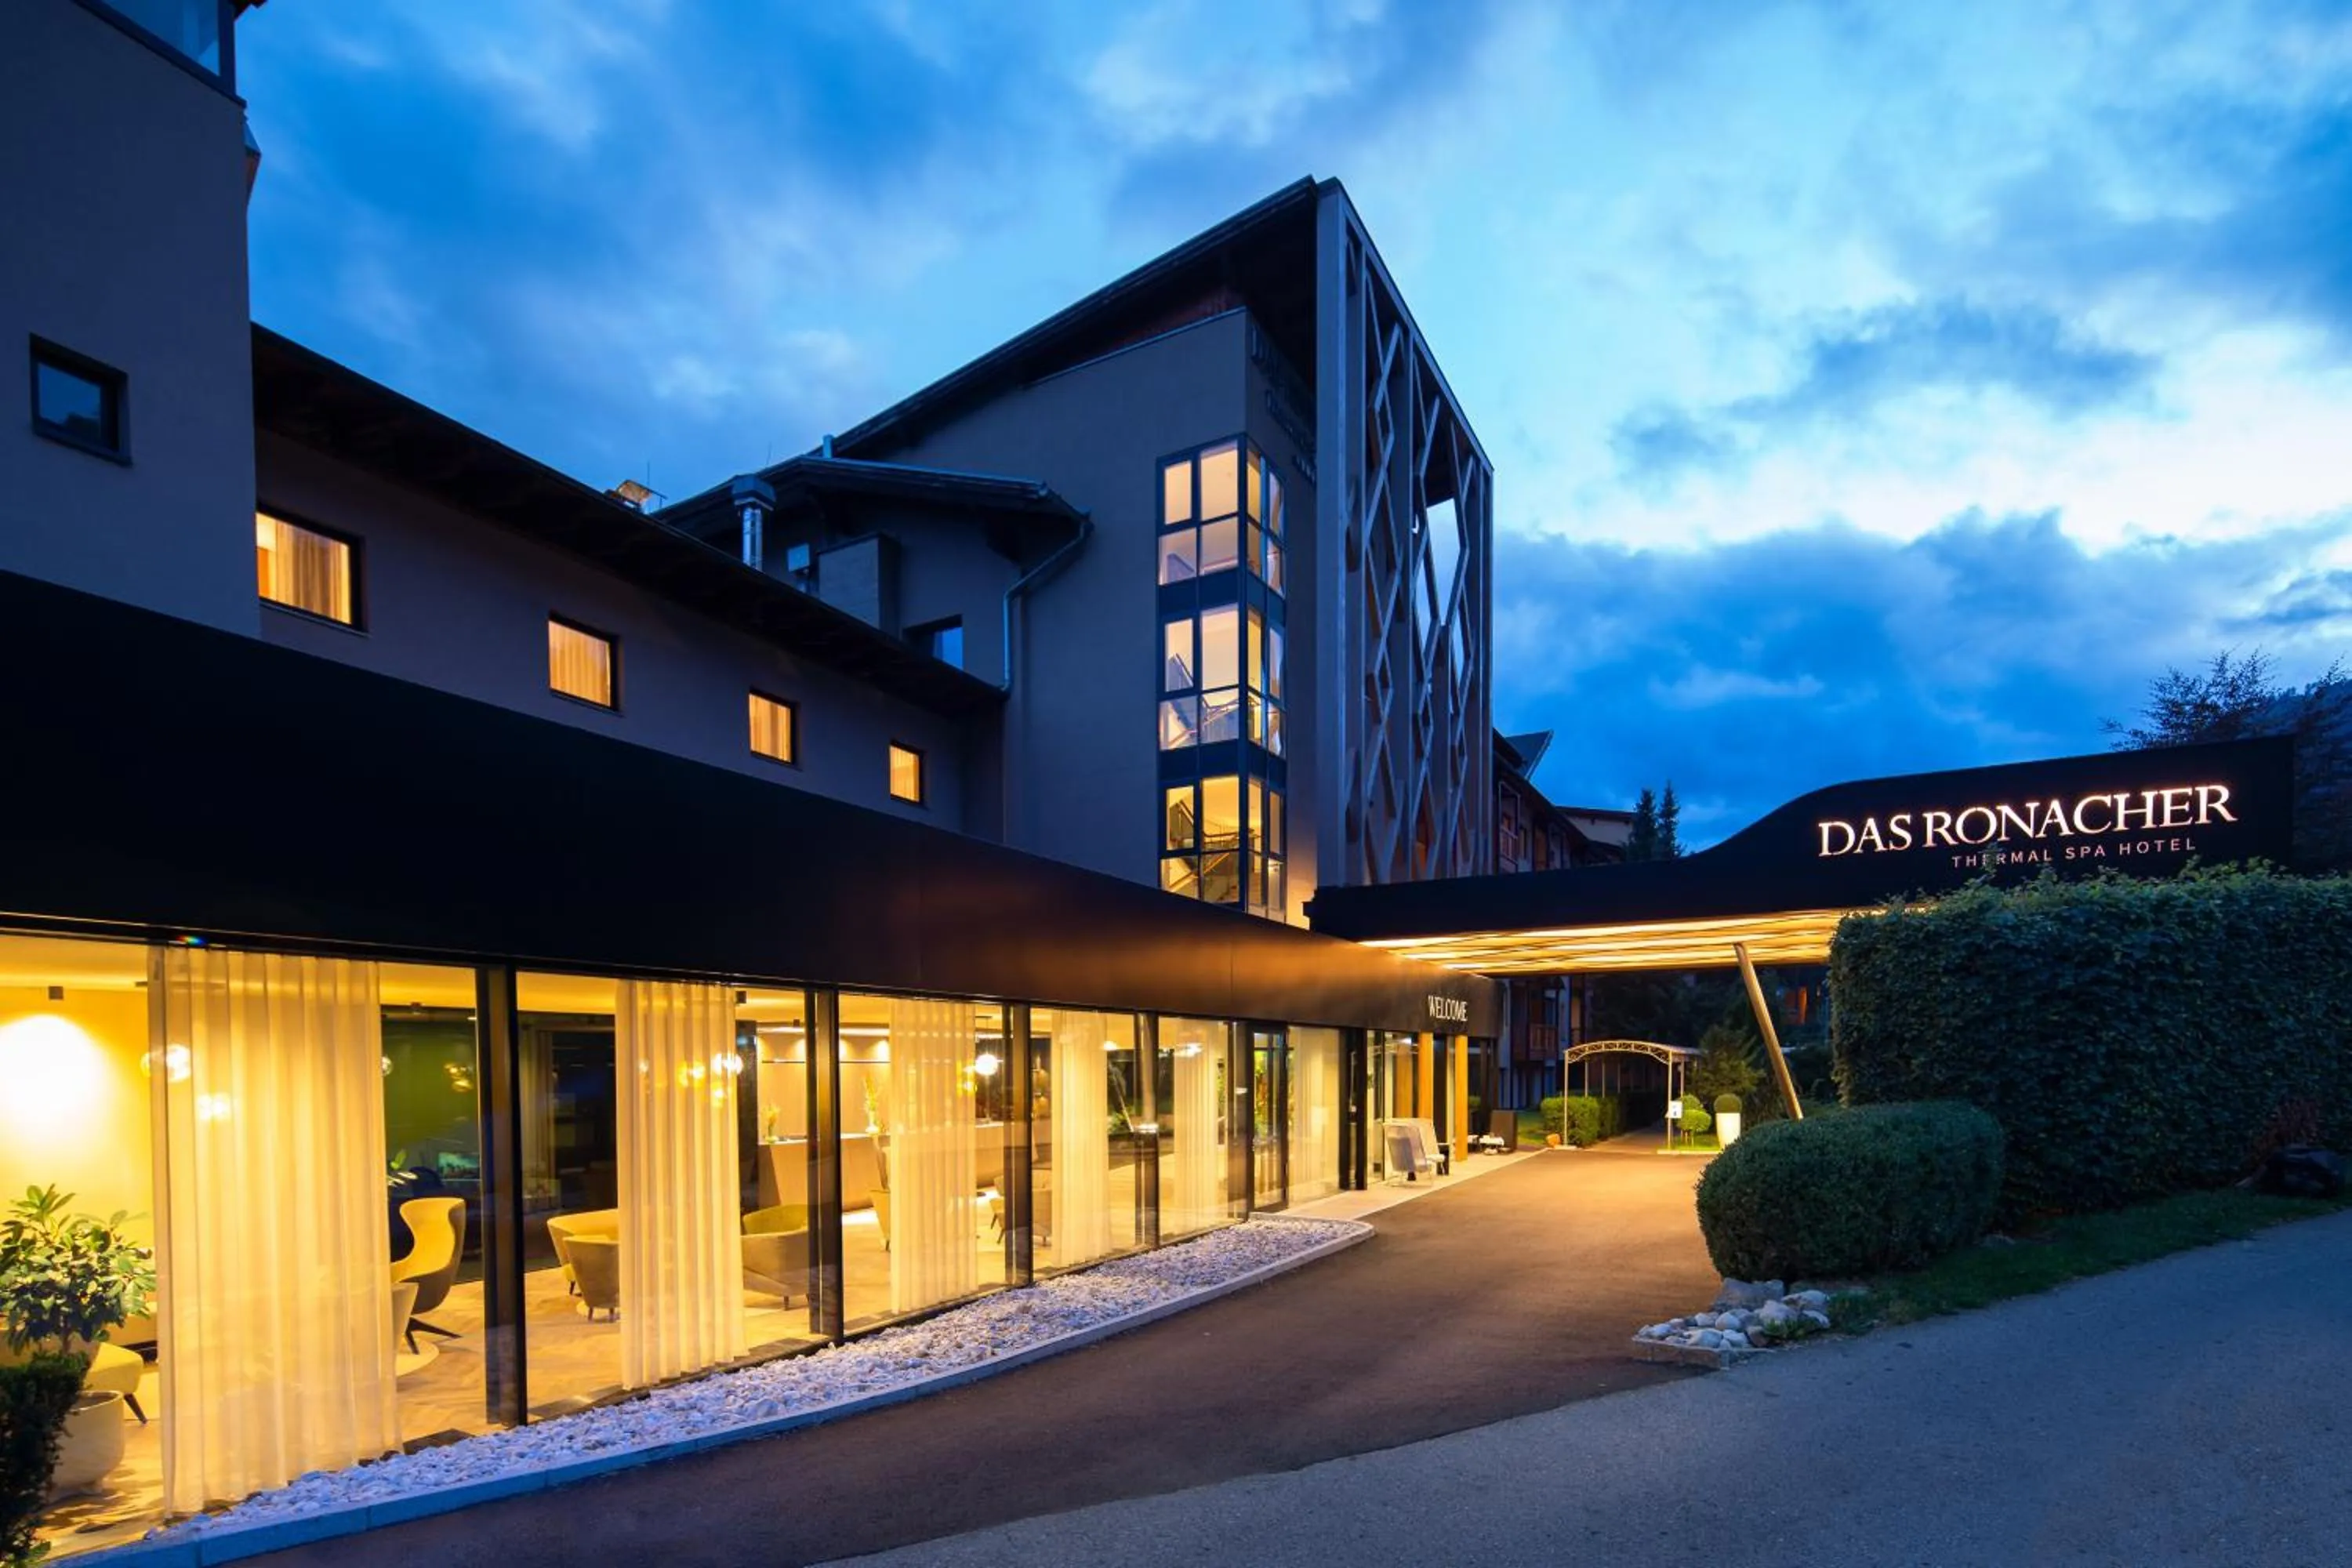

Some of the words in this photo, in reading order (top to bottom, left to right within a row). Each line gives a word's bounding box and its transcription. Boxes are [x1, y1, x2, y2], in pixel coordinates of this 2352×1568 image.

[1818, 814, 1912, 856] DAS
[1922, 785, 2238, 848] RONACHER
[2065, 845, 2106, 859] SPA
[2119, 837, 2195, 855] HOTEL
[1428, 995, 1468, 1022] WELCOME
